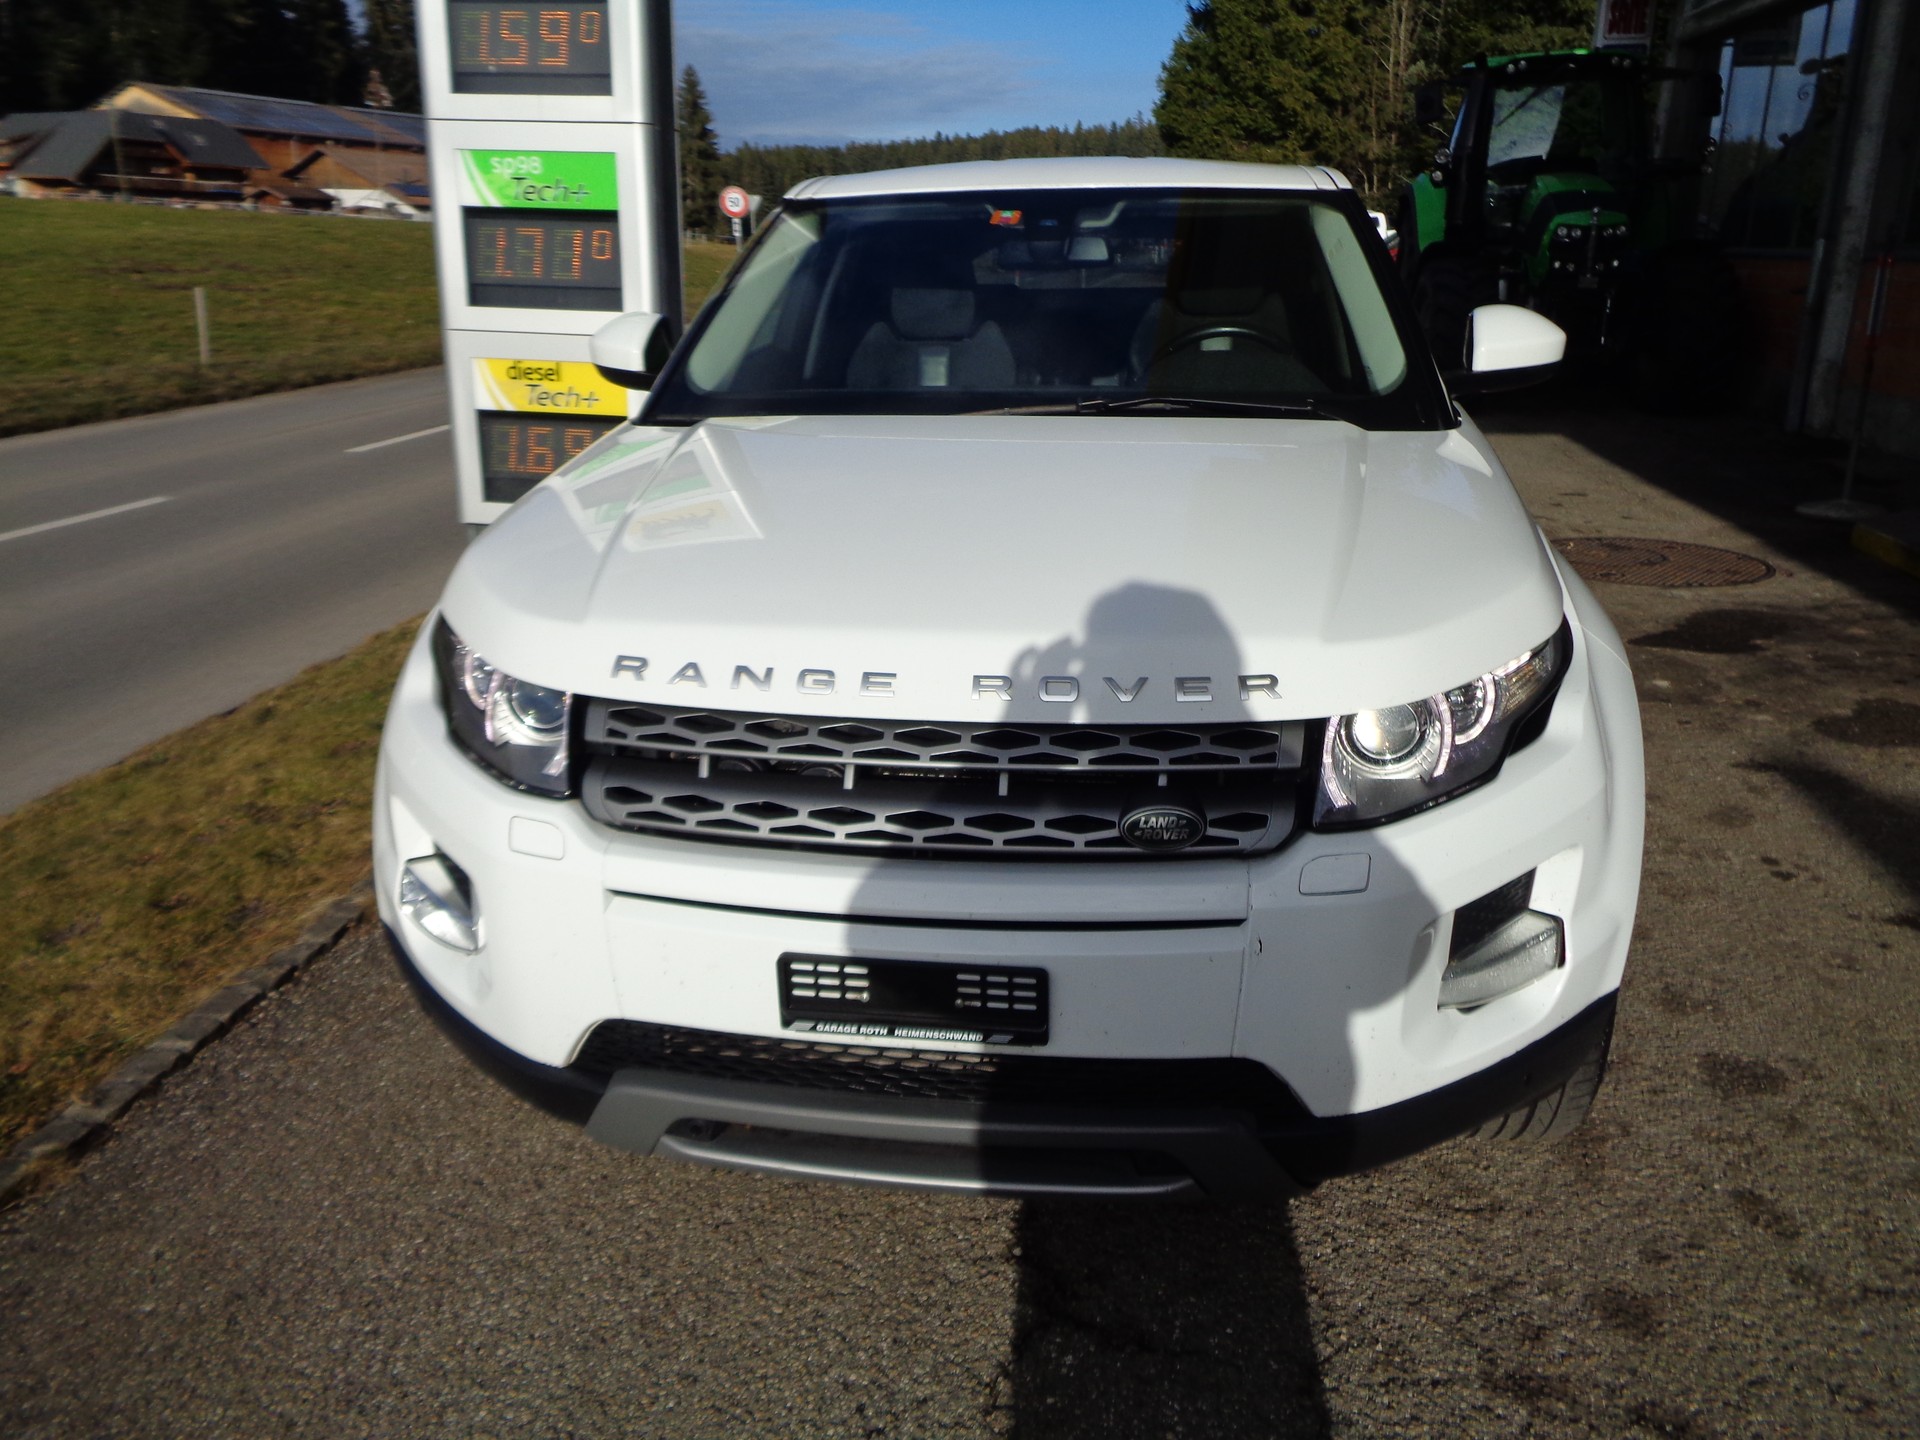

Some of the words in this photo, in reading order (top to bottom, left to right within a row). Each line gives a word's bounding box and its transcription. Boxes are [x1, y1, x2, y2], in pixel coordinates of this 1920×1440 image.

[490, 156, 544, 178] sp98
[510, 176, 590, 203] Tech+
[727, 196, 740, 208] 50
[506, 361, 563, 382] diesel
[524, 384, 600, 408] Tech+
[610, 654, 897, 698] RANGE
[971, 674, 1283, 702] ROVER
[1139, 816, 1178, 829] LAND
[1142, 828, 1189, 840] ROVER
[816, 1023, 858, 1034] GARAGE
[859, 1025, 888, 1036] ROTH
[894, 1027, 984, 1042] HEIMENSCHWAND
